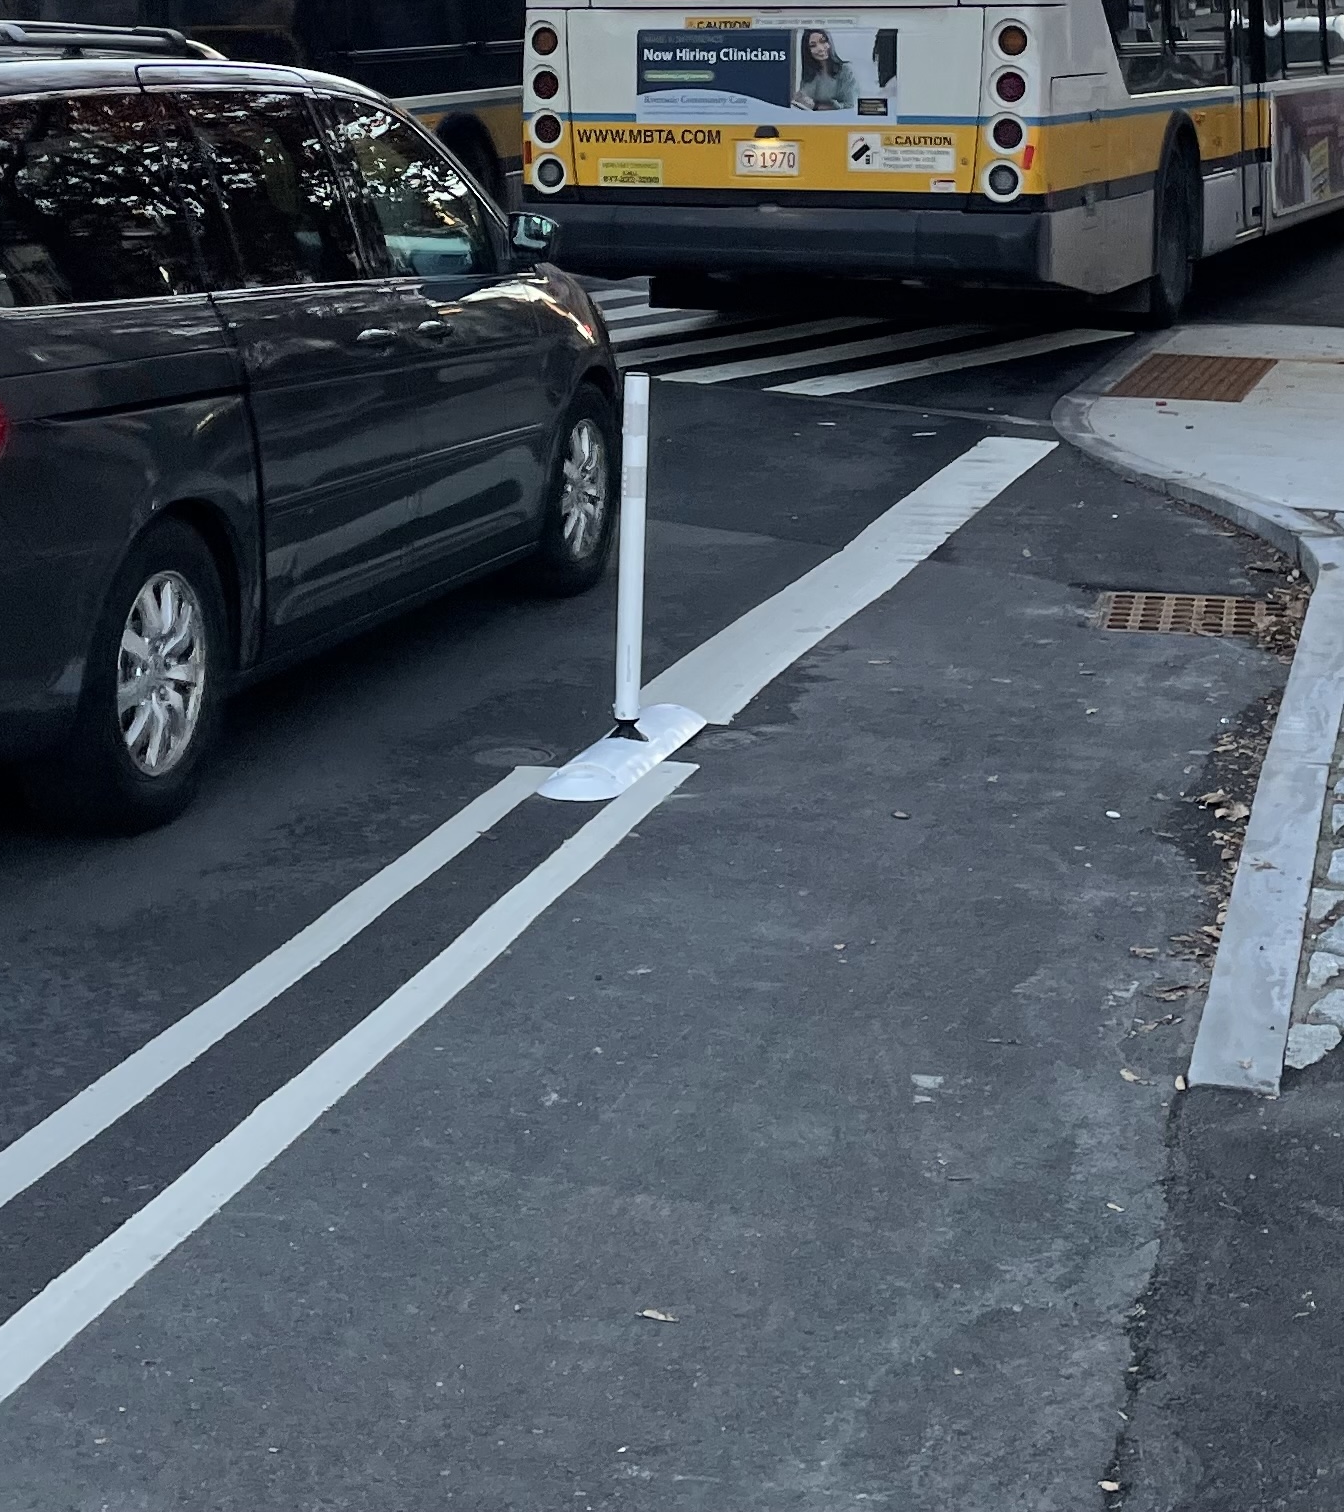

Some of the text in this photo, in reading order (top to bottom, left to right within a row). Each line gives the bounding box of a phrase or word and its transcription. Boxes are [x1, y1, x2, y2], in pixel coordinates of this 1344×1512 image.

[643, 48, 787, 64] Now Hiring Clinicians
[576, 129, 721, 144] WWW.MBTA.COM
[894, 136, 952, 146] CAUTION
[760, 151, 796, 168] 1970
